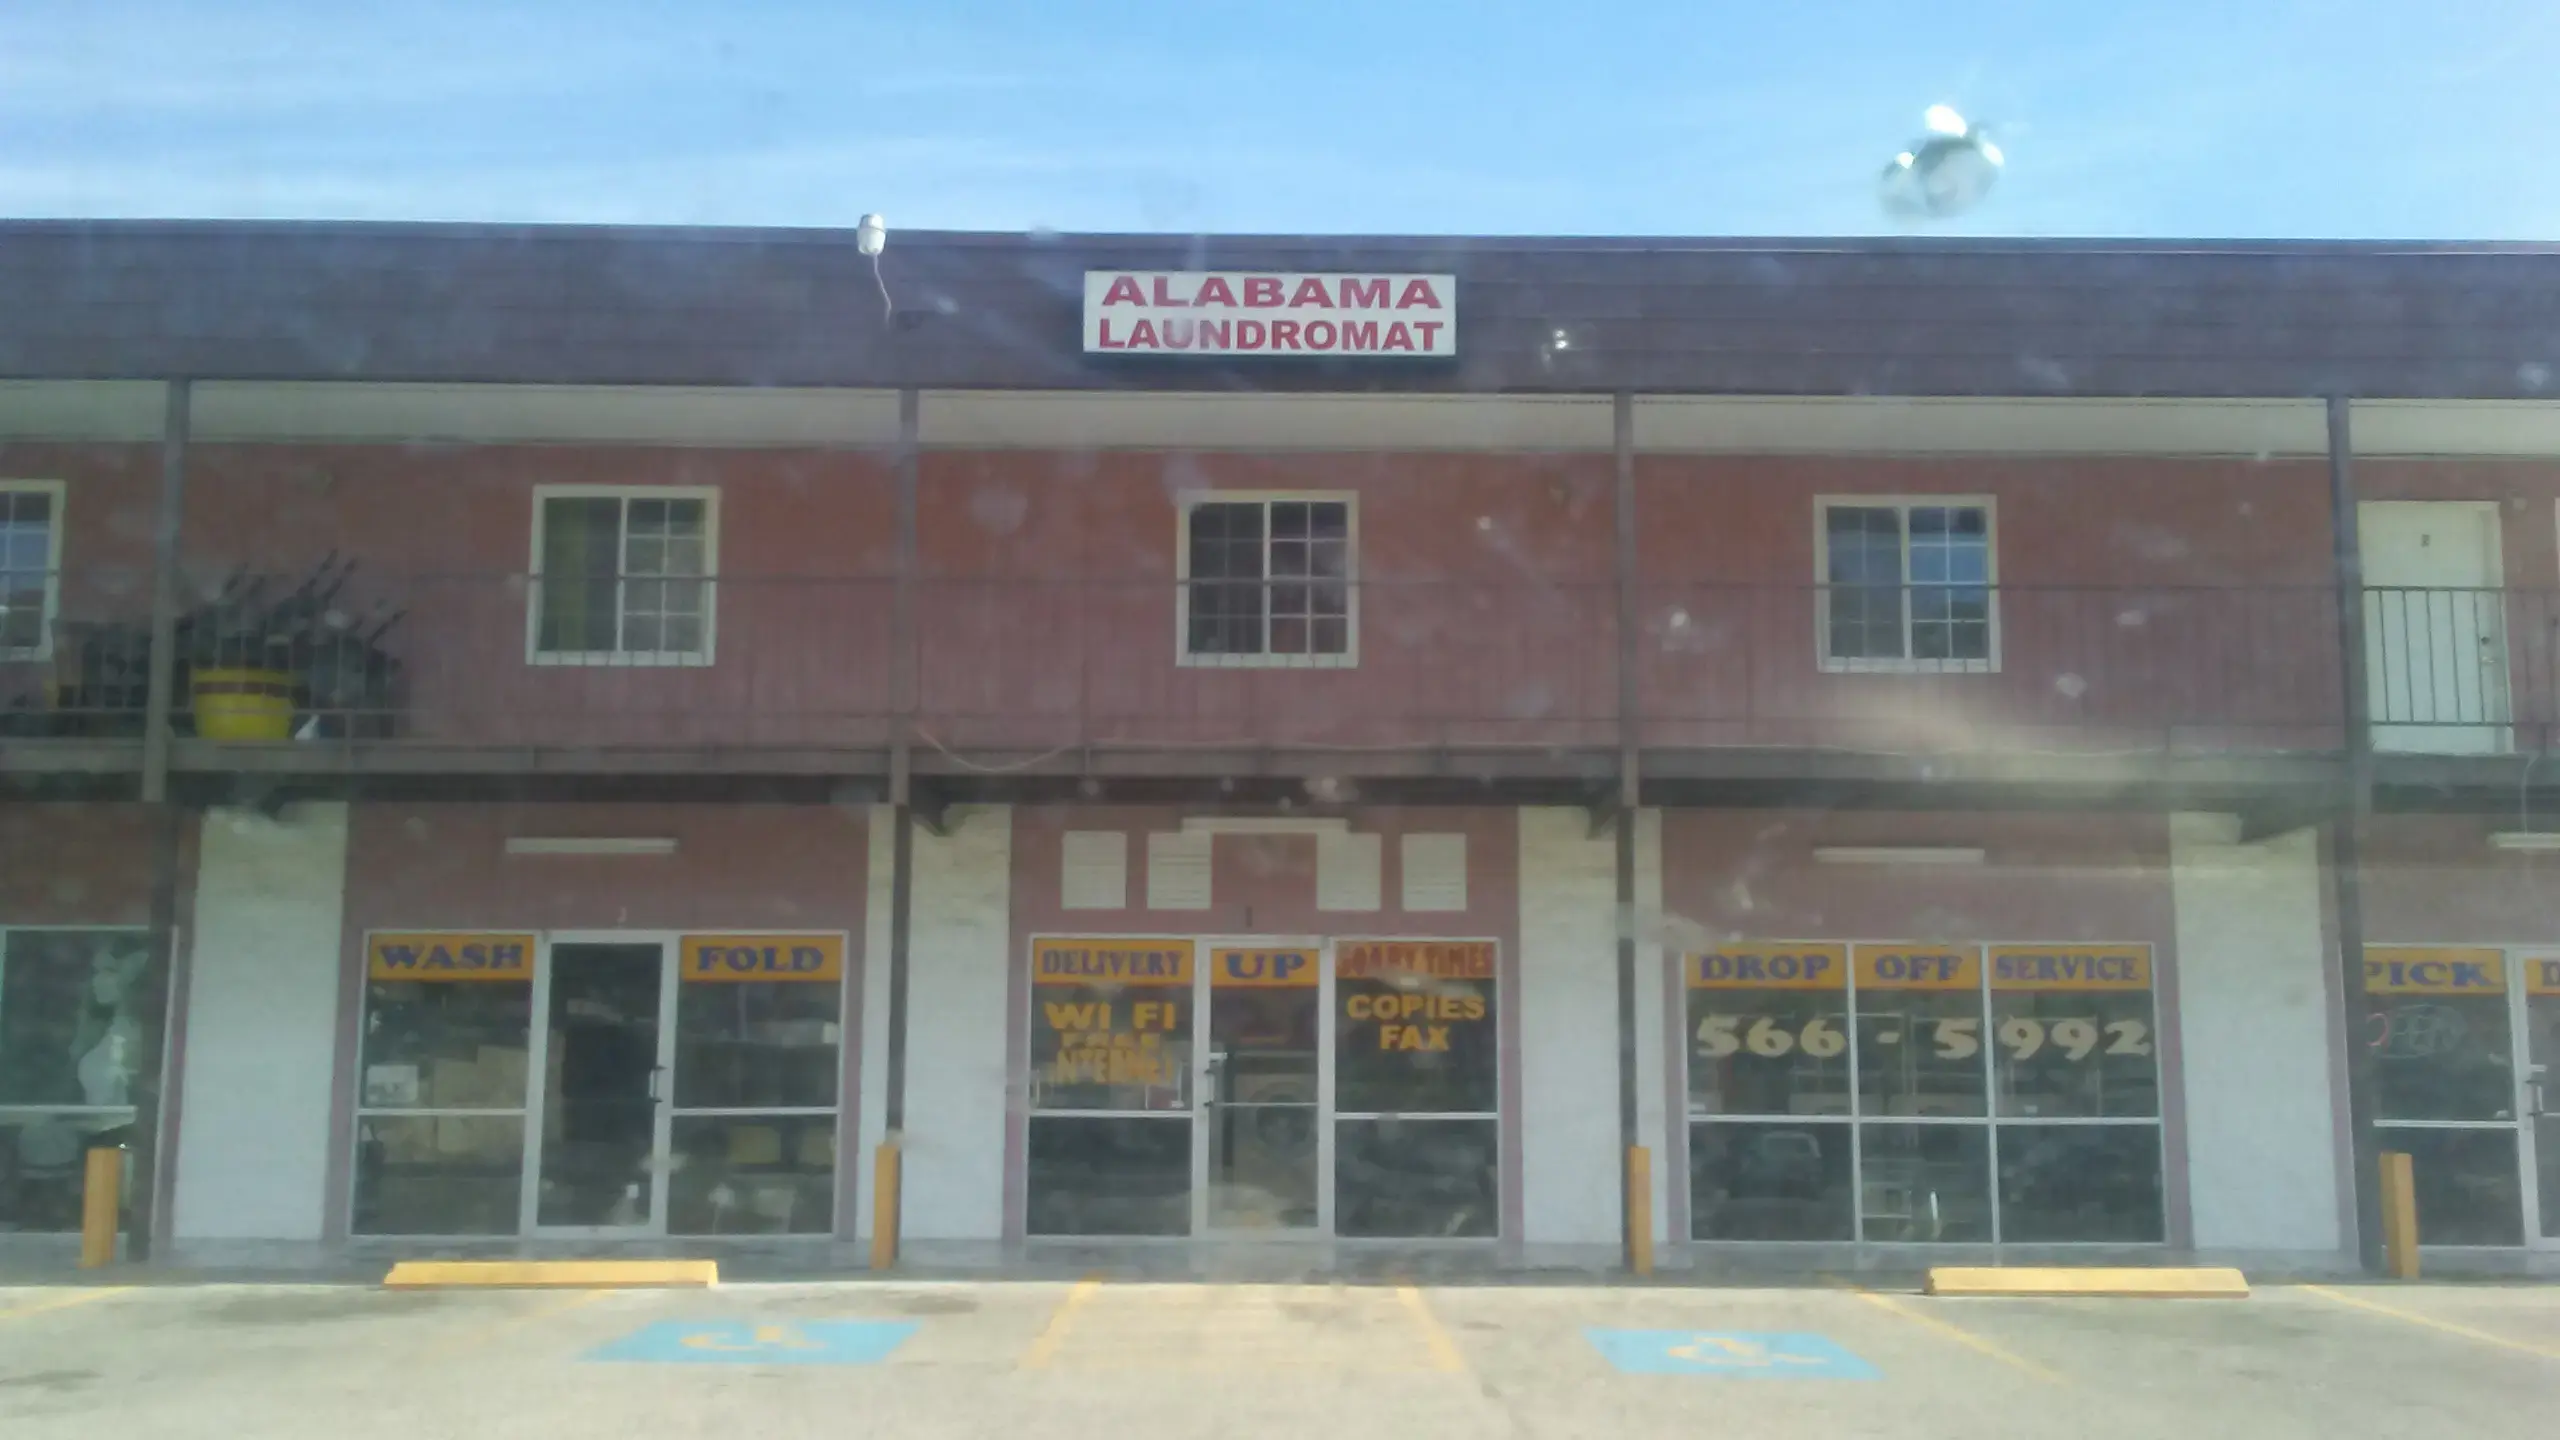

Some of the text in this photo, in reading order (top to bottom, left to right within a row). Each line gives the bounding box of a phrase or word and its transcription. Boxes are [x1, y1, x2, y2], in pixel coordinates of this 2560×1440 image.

[1102, 276, 1443, 310] ALABAMA
[1099, 318, 1444, 352] LAUNDROMAT
[380, 944, 523, 970] WASH
[697, 946, 825, 973] FOLD
[1042, 949, 1183, 978] DELIVERY
[1226, 952, 1306, 979] UP
[1700, 954, 1831, 982] DROP
[1874, 955, 1963, 982] OFF
[1995, 955, 2143, 982] SERVICE
[2364, 961, 2495, 987] PICK
[1044, 1001, 1176, 1031] WI FI
[1347, 994, 1486, 1020] COPIES
[1379, 1025, 1450, 1051] FAX
